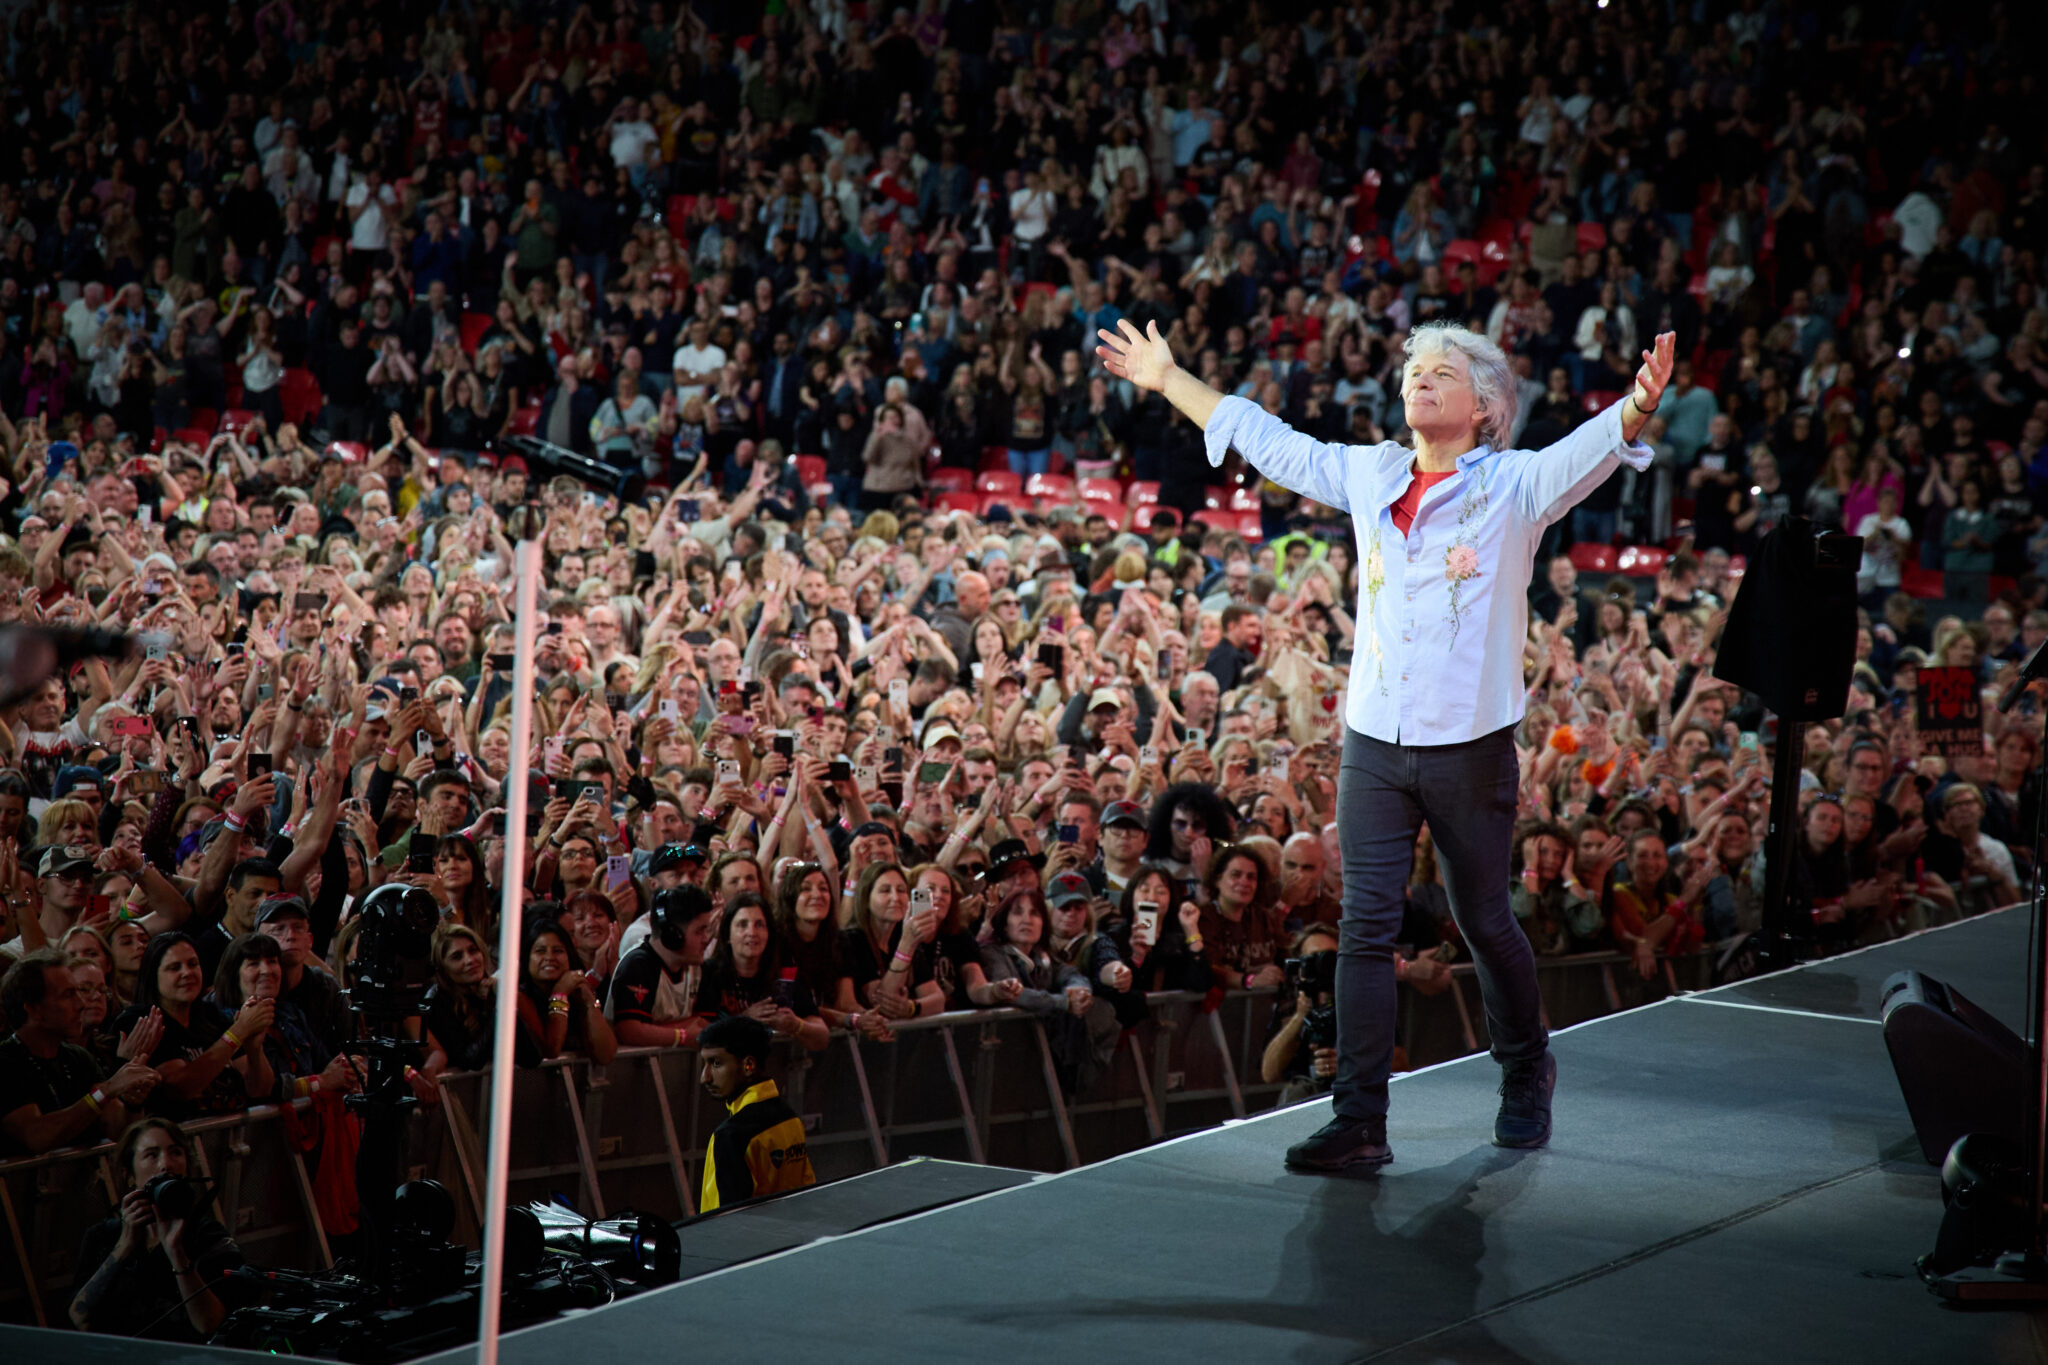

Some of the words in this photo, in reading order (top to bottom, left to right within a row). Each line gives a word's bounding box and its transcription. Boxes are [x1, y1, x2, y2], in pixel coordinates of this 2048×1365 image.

[1963, 703, 1979, 719] U
[1920, 729, 1954, 742] GIVE
[1957, 729, 1979, 742] ME
